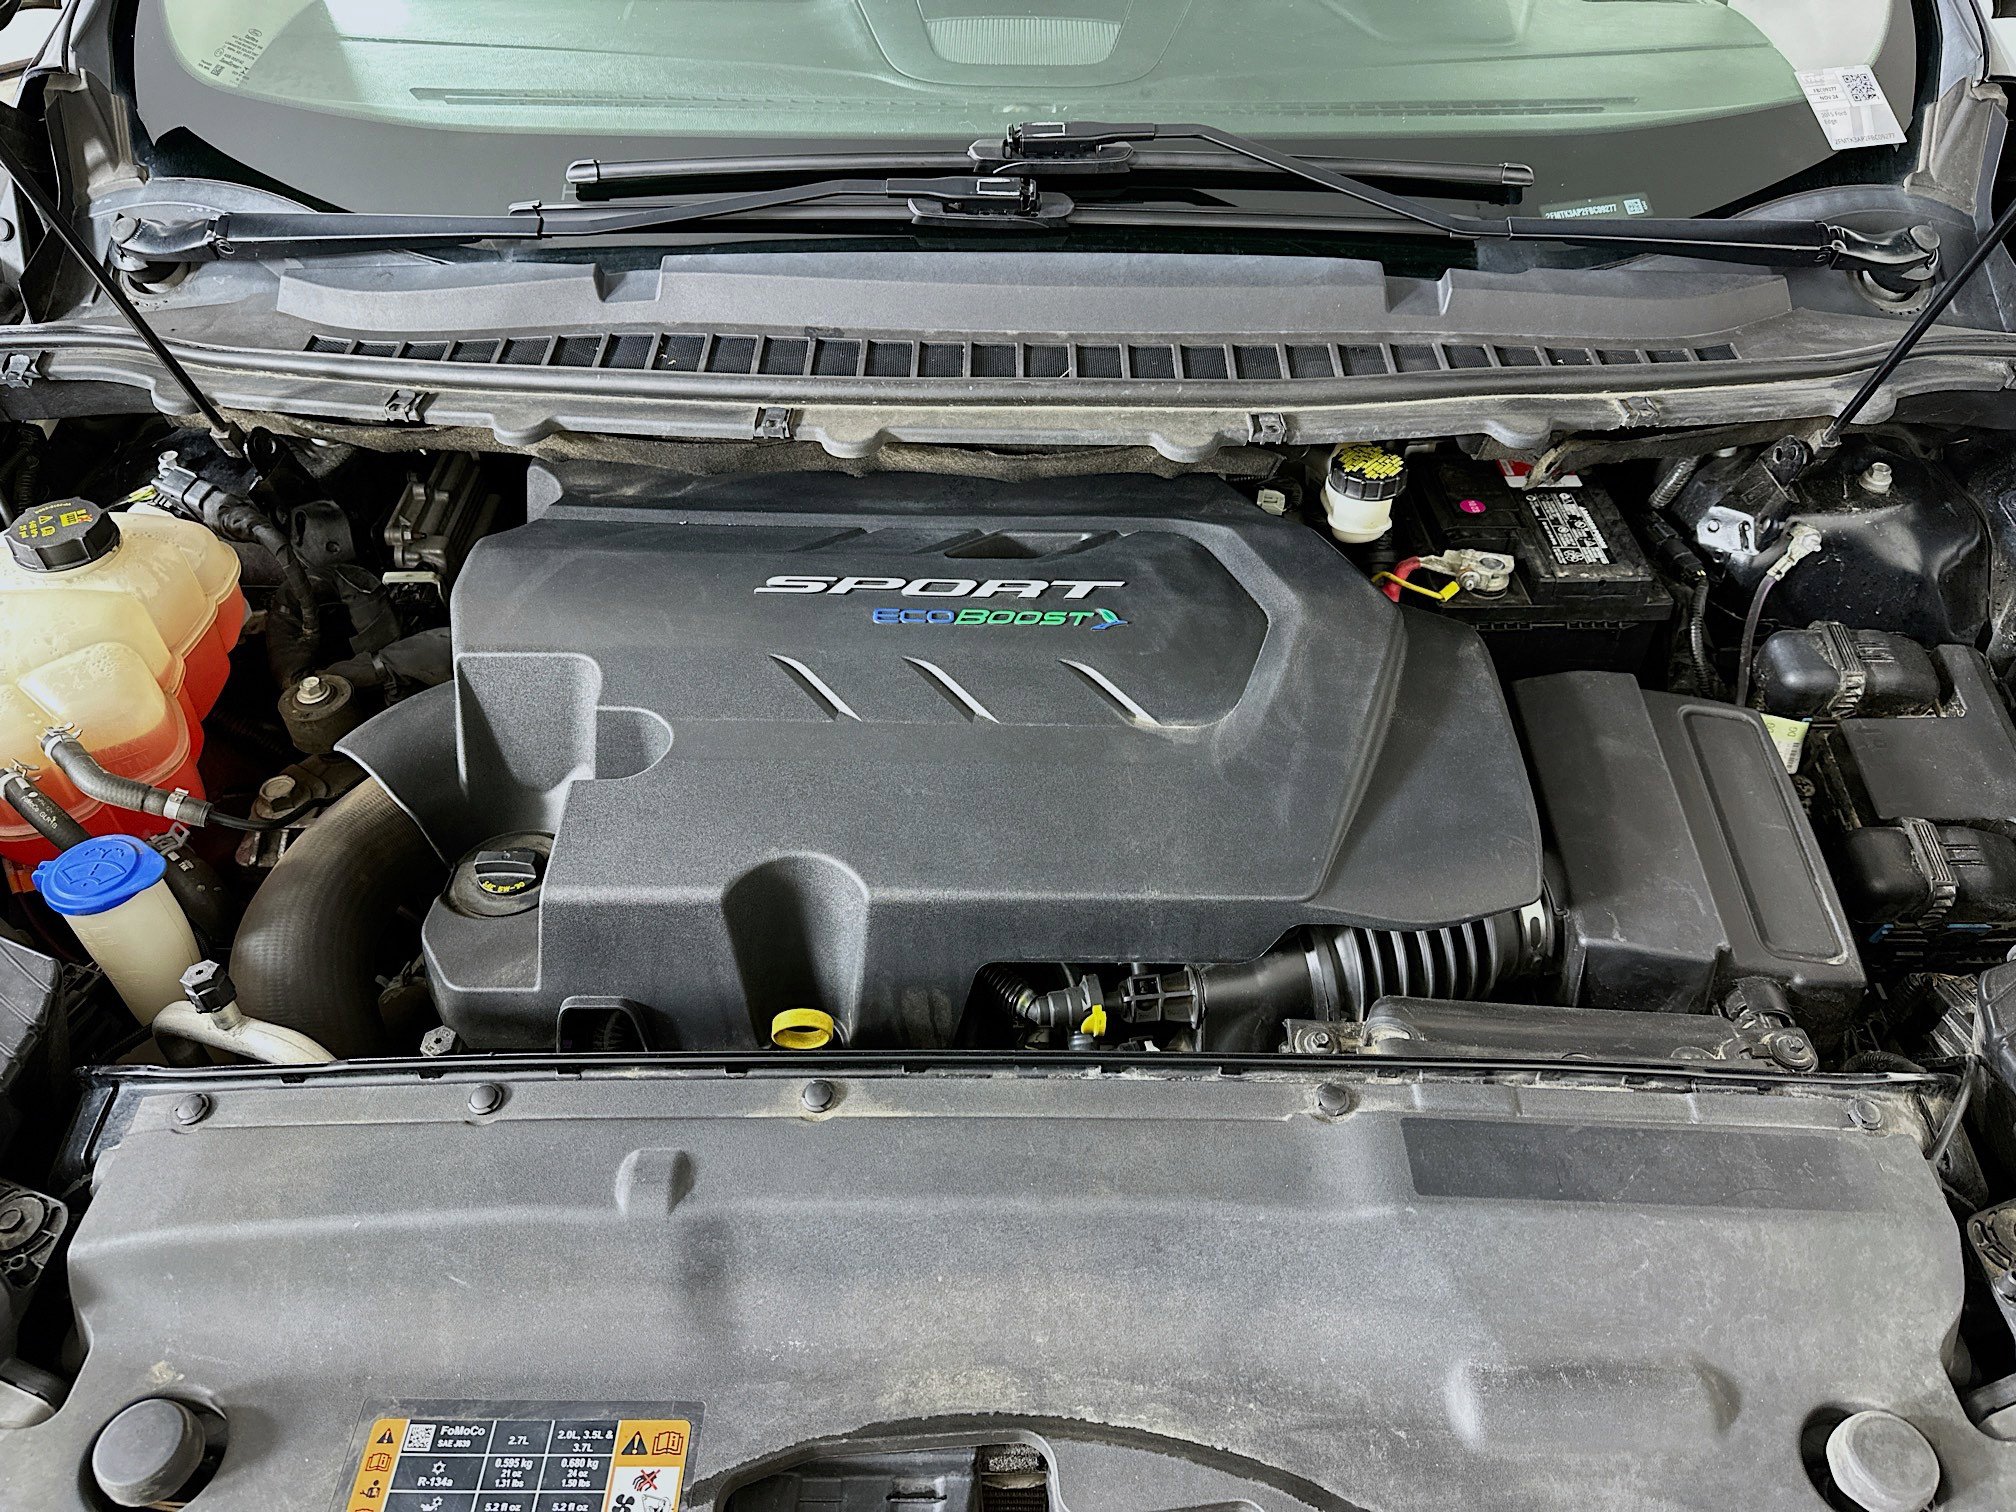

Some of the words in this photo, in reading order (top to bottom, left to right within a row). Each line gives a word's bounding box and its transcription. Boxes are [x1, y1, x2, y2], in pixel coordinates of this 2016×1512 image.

[754, 575, 1126, 600] SPORT
[440, 1425, 486, 1436] FoMoCo
[557, 1430, 581, 1440] 2.0L,
[583, 1430, 604, 1440] 3.5L
[605, 1430, 614, 1440] &
[437, 1439, 454, 1448] SAE
[508, 1436, 529, 1446] 2.7L
[572, 1443, 594, 1453] 3.7L
[494, 1458, 521, 1468] 0.595
[520, 1458, 534, 1470] kg
[560, 1458, 586, 1468] 0.680
[587, 1458, 600, 1470] kg
[500, 1469, 511, 1478] 21
[511, 1470, 523, 1478] oz
[567, 1469, 578, 1478] 24
[578, 1470, 589, 1478] oz
[417, 1476, 454, 1487] R-134a
[494, 1479, 511, 1487] 1.31
[511, 1479, 525, 1487] lbs
[578, 1479, 591, 1487] lbs
[484, 1502, 500, 1512] 5.2
[509, 1504, 522, 1512] oz
[551, 1502, 567, 1512] 5.2
[576, 1504, 589, 1512] oz
